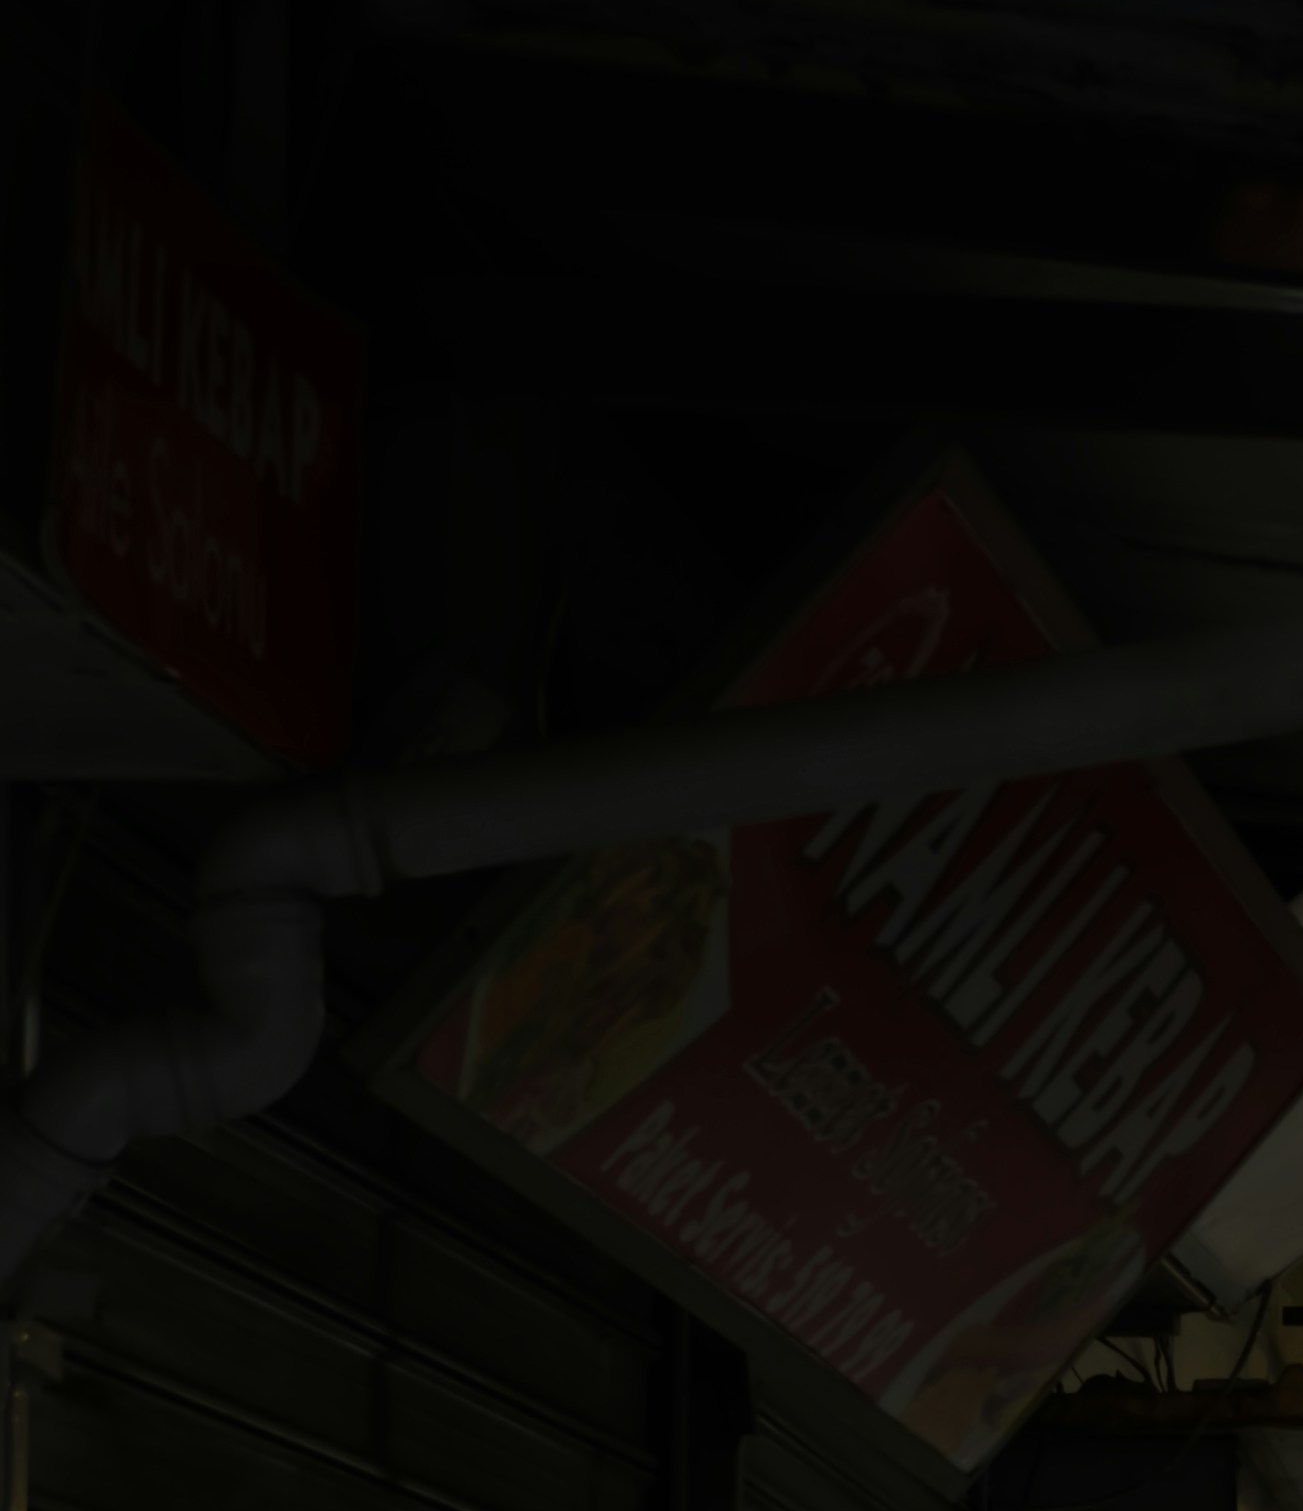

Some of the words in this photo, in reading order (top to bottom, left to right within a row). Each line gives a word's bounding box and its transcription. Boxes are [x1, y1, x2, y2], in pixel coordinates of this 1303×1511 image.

[176, 267, 324, 505] KEBAP
[999, 896, 1257, 1206] KEBAP
[600, 1099, 726, 1228] Paket
[804, 1279, 885, 1358] 79
[837, 1308, 915, 1384] 99
